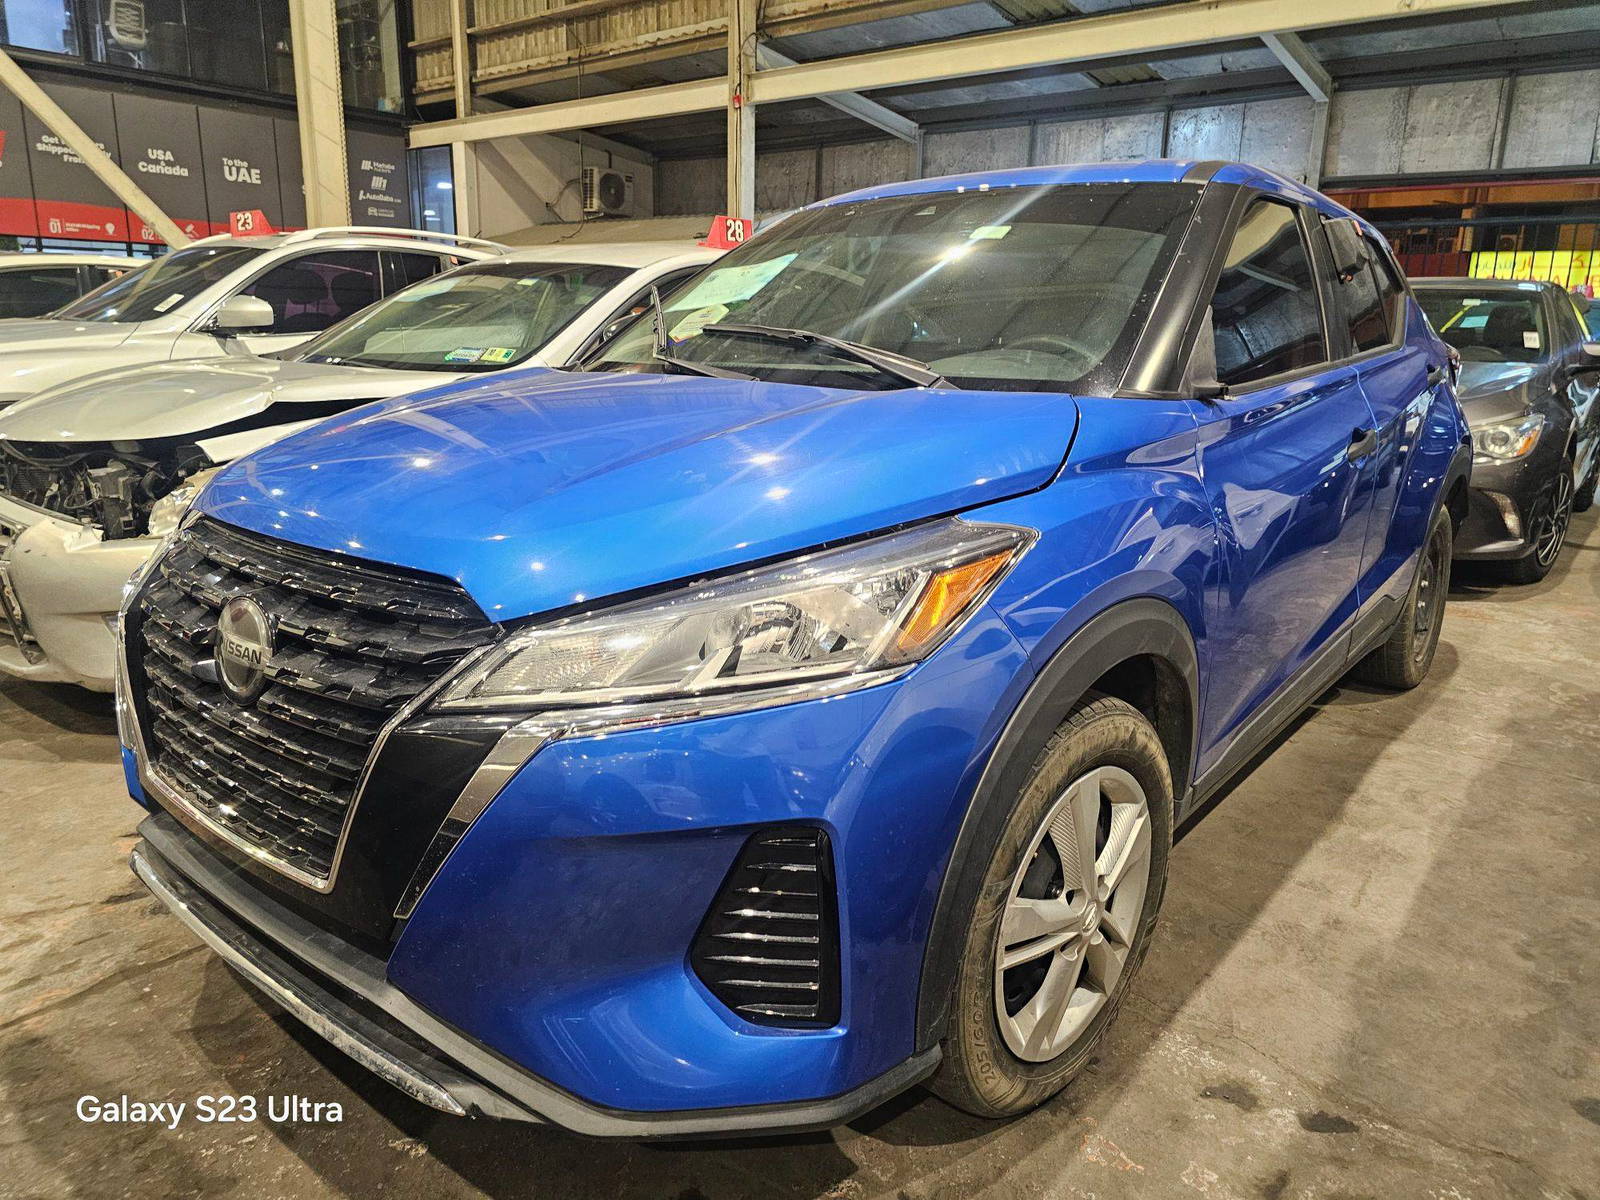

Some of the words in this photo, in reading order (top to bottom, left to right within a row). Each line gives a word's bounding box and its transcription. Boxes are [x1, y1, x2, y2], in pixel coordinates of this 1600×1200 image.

[147, 148, 174, 161] USA
[222, 157, 233, 166] To
[233, 159, 248, 168] the
[138, 161, 189, 177] Canada
[223, 165, 262, 184] UAE
[236, 212, 253, 231] 23
[726, 219, 744, 243] 28
[223, 637, 262, 665] ISSAN
